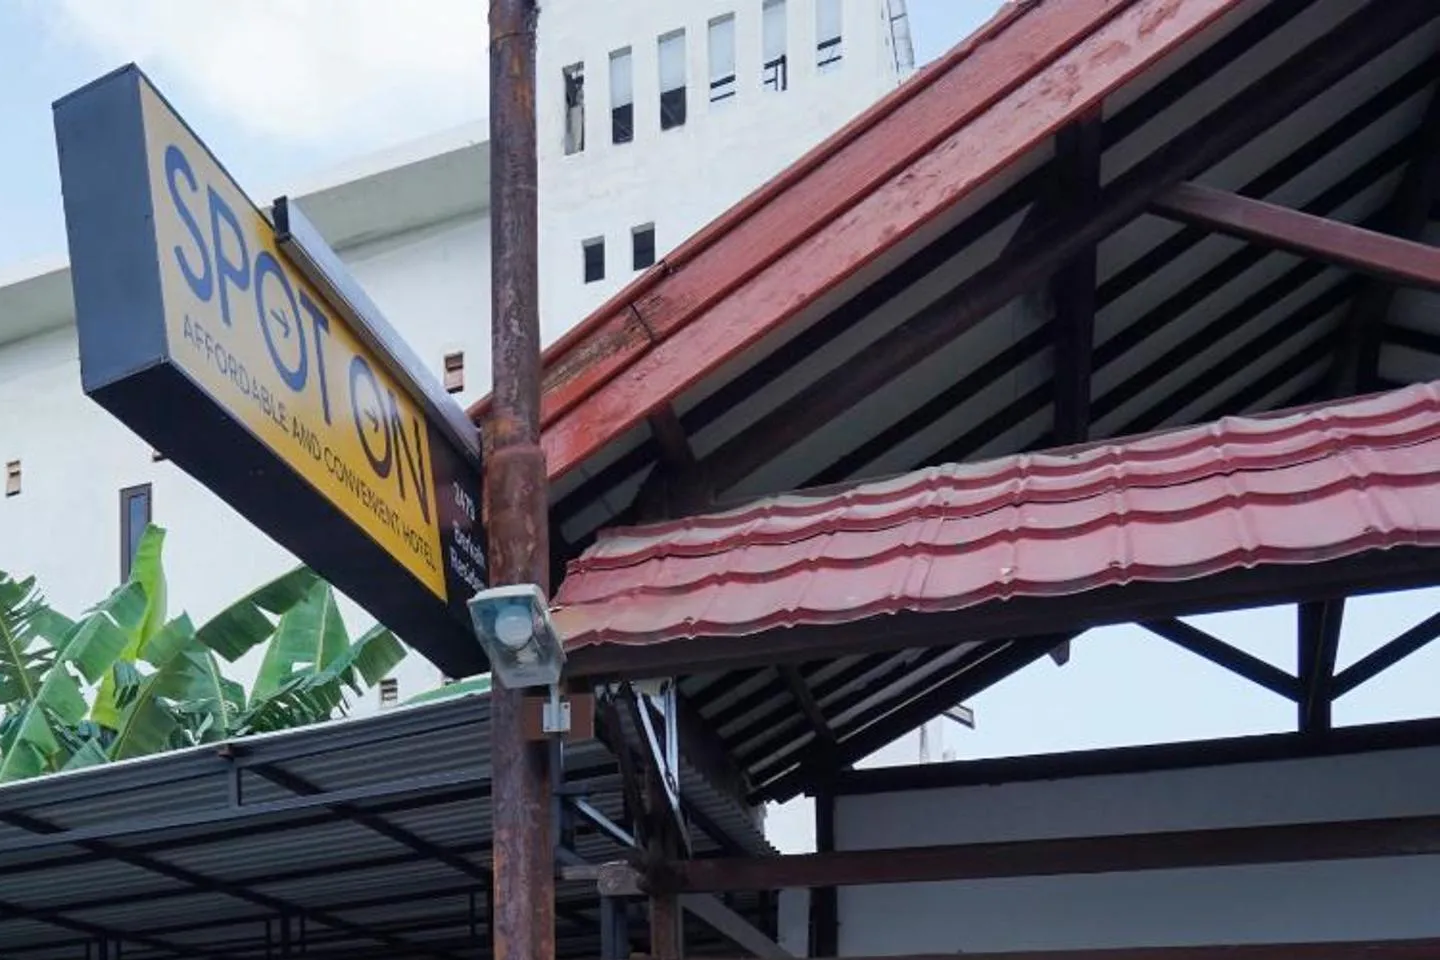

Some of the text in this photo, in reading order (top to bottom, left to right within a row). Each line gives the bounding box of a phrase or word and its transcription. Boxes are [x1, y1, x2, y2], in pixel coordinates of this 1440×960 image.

[165, 145, 432, 525] SPOT ON
[183, 314, 437, 572] AFFORDABLE AND CONVENIENT HOTEL
